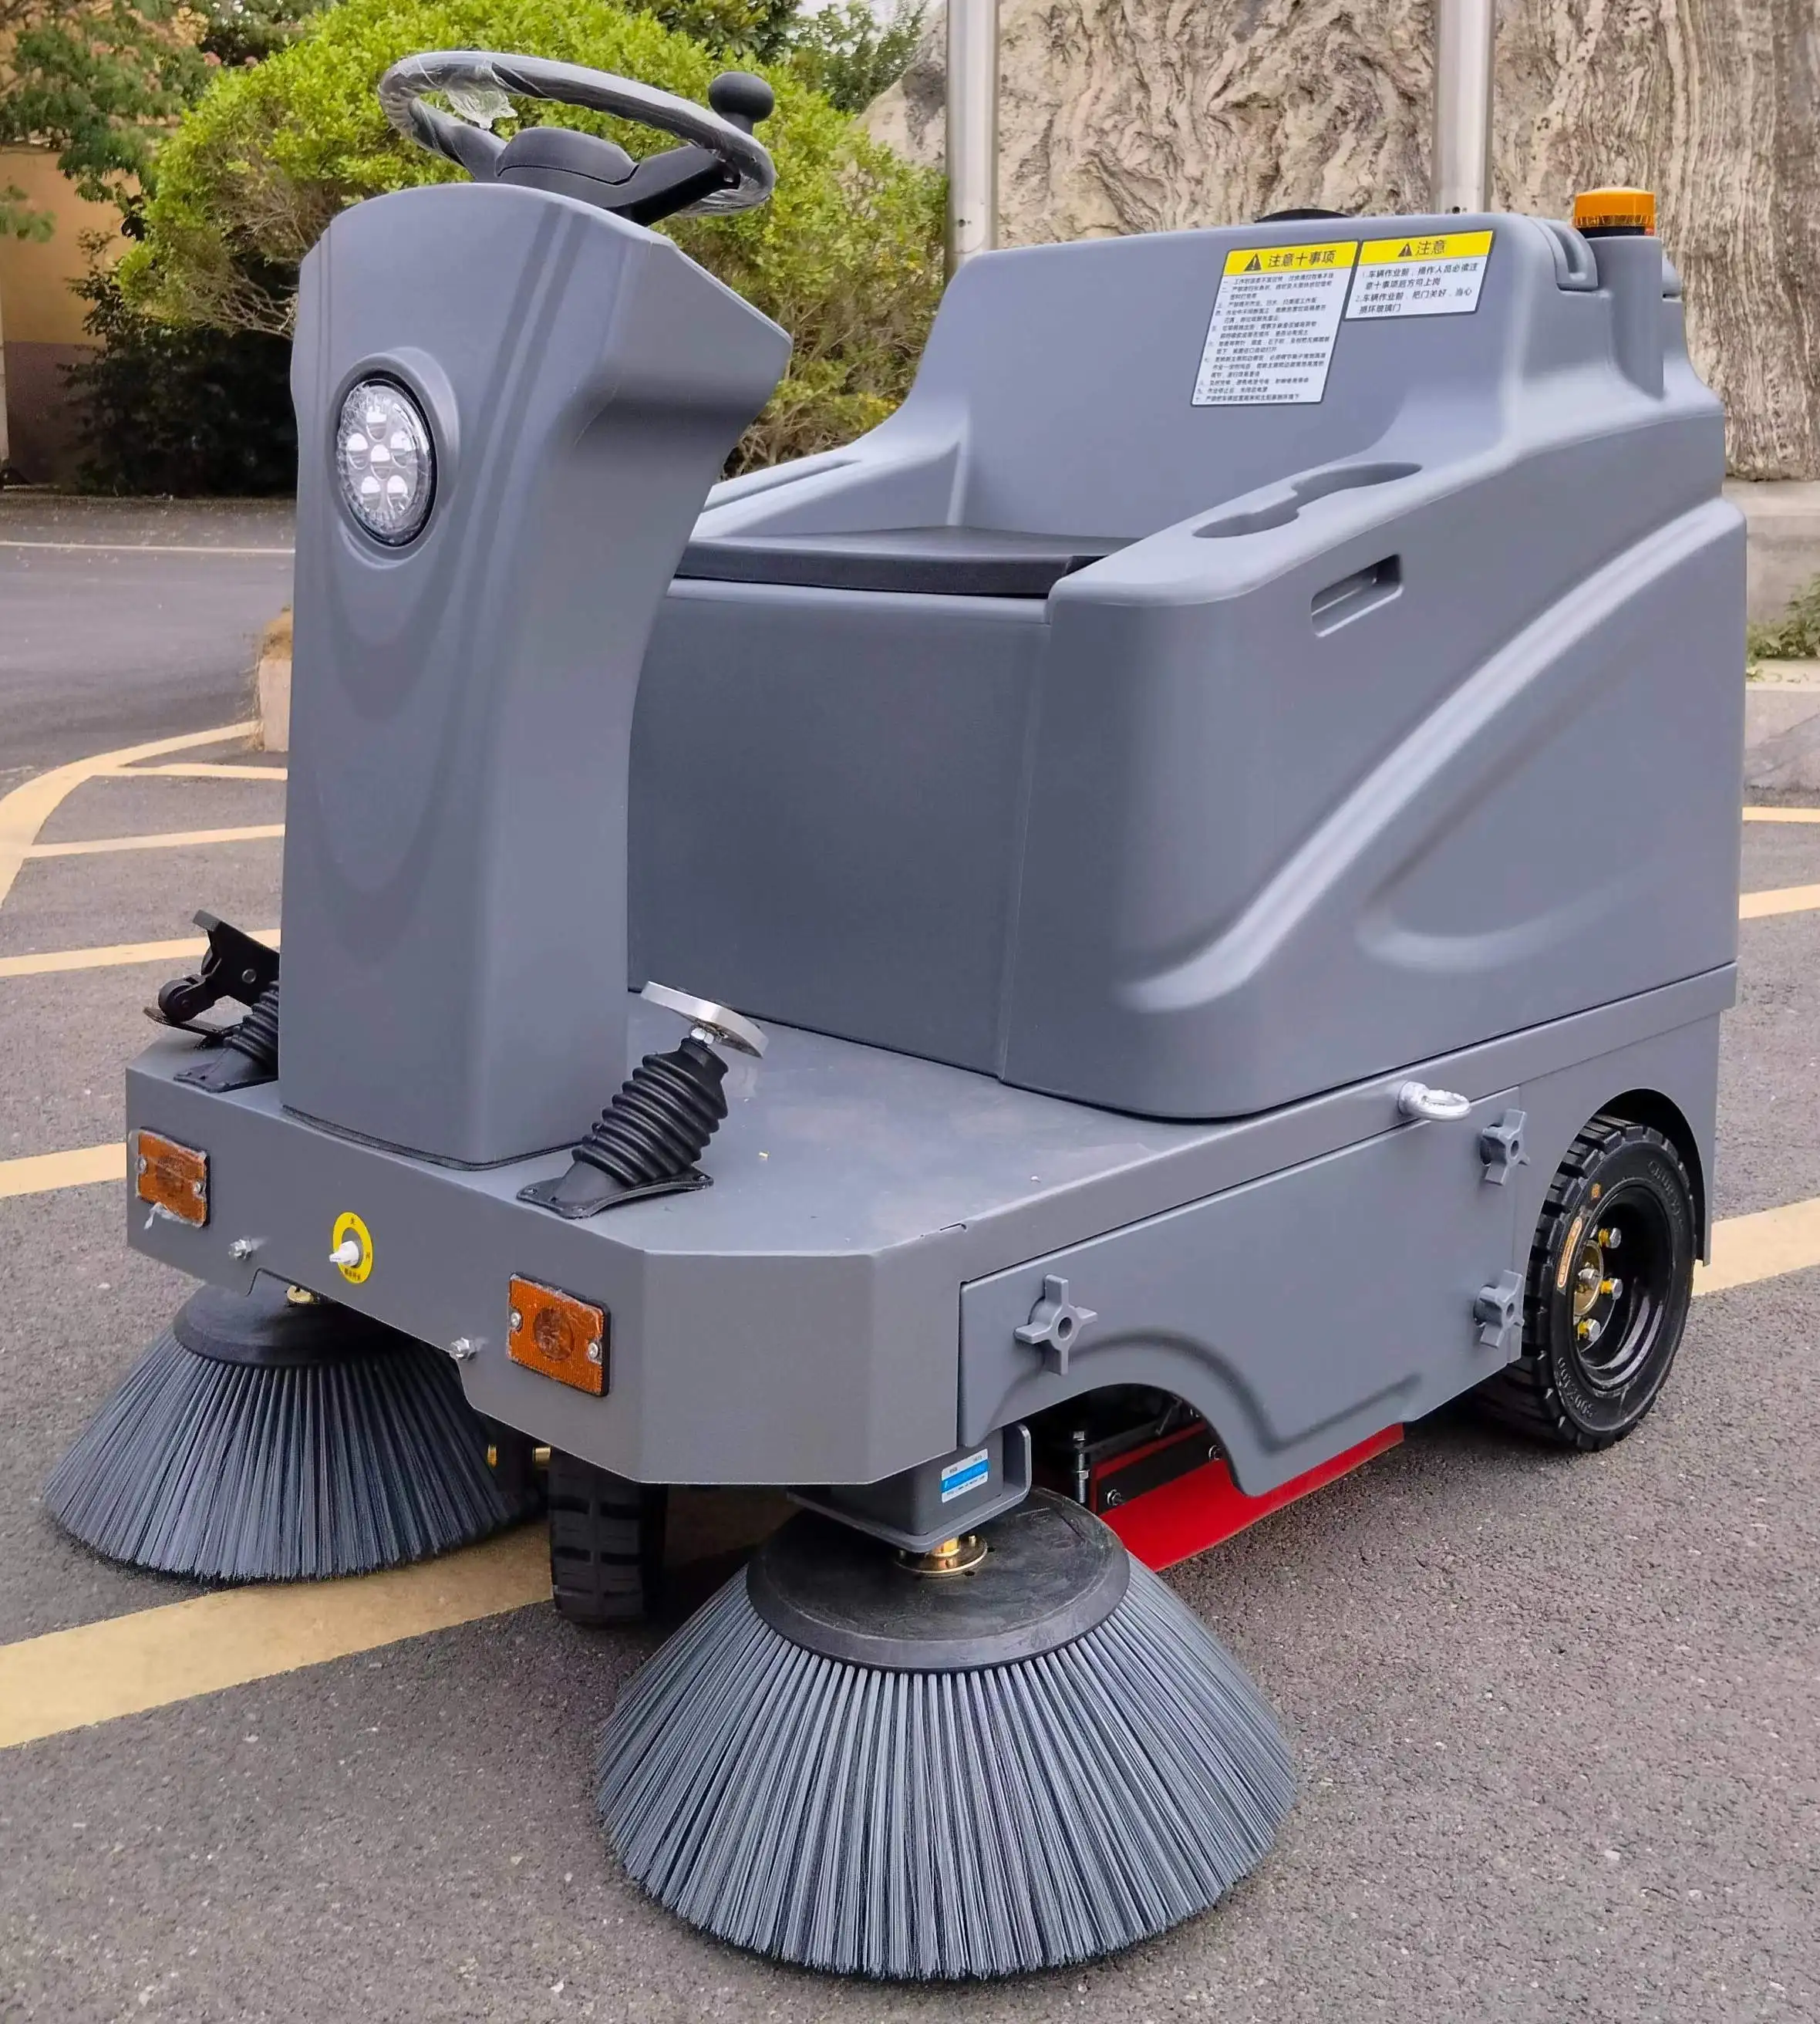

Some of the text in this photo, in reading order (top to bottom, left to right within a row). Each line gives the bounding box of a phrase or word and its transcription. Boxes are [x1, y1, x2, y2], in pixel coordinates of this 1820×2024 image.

[1415, 239, 1447, 256] 注意
[1268, 250, 1336, 268] 注意十事项
